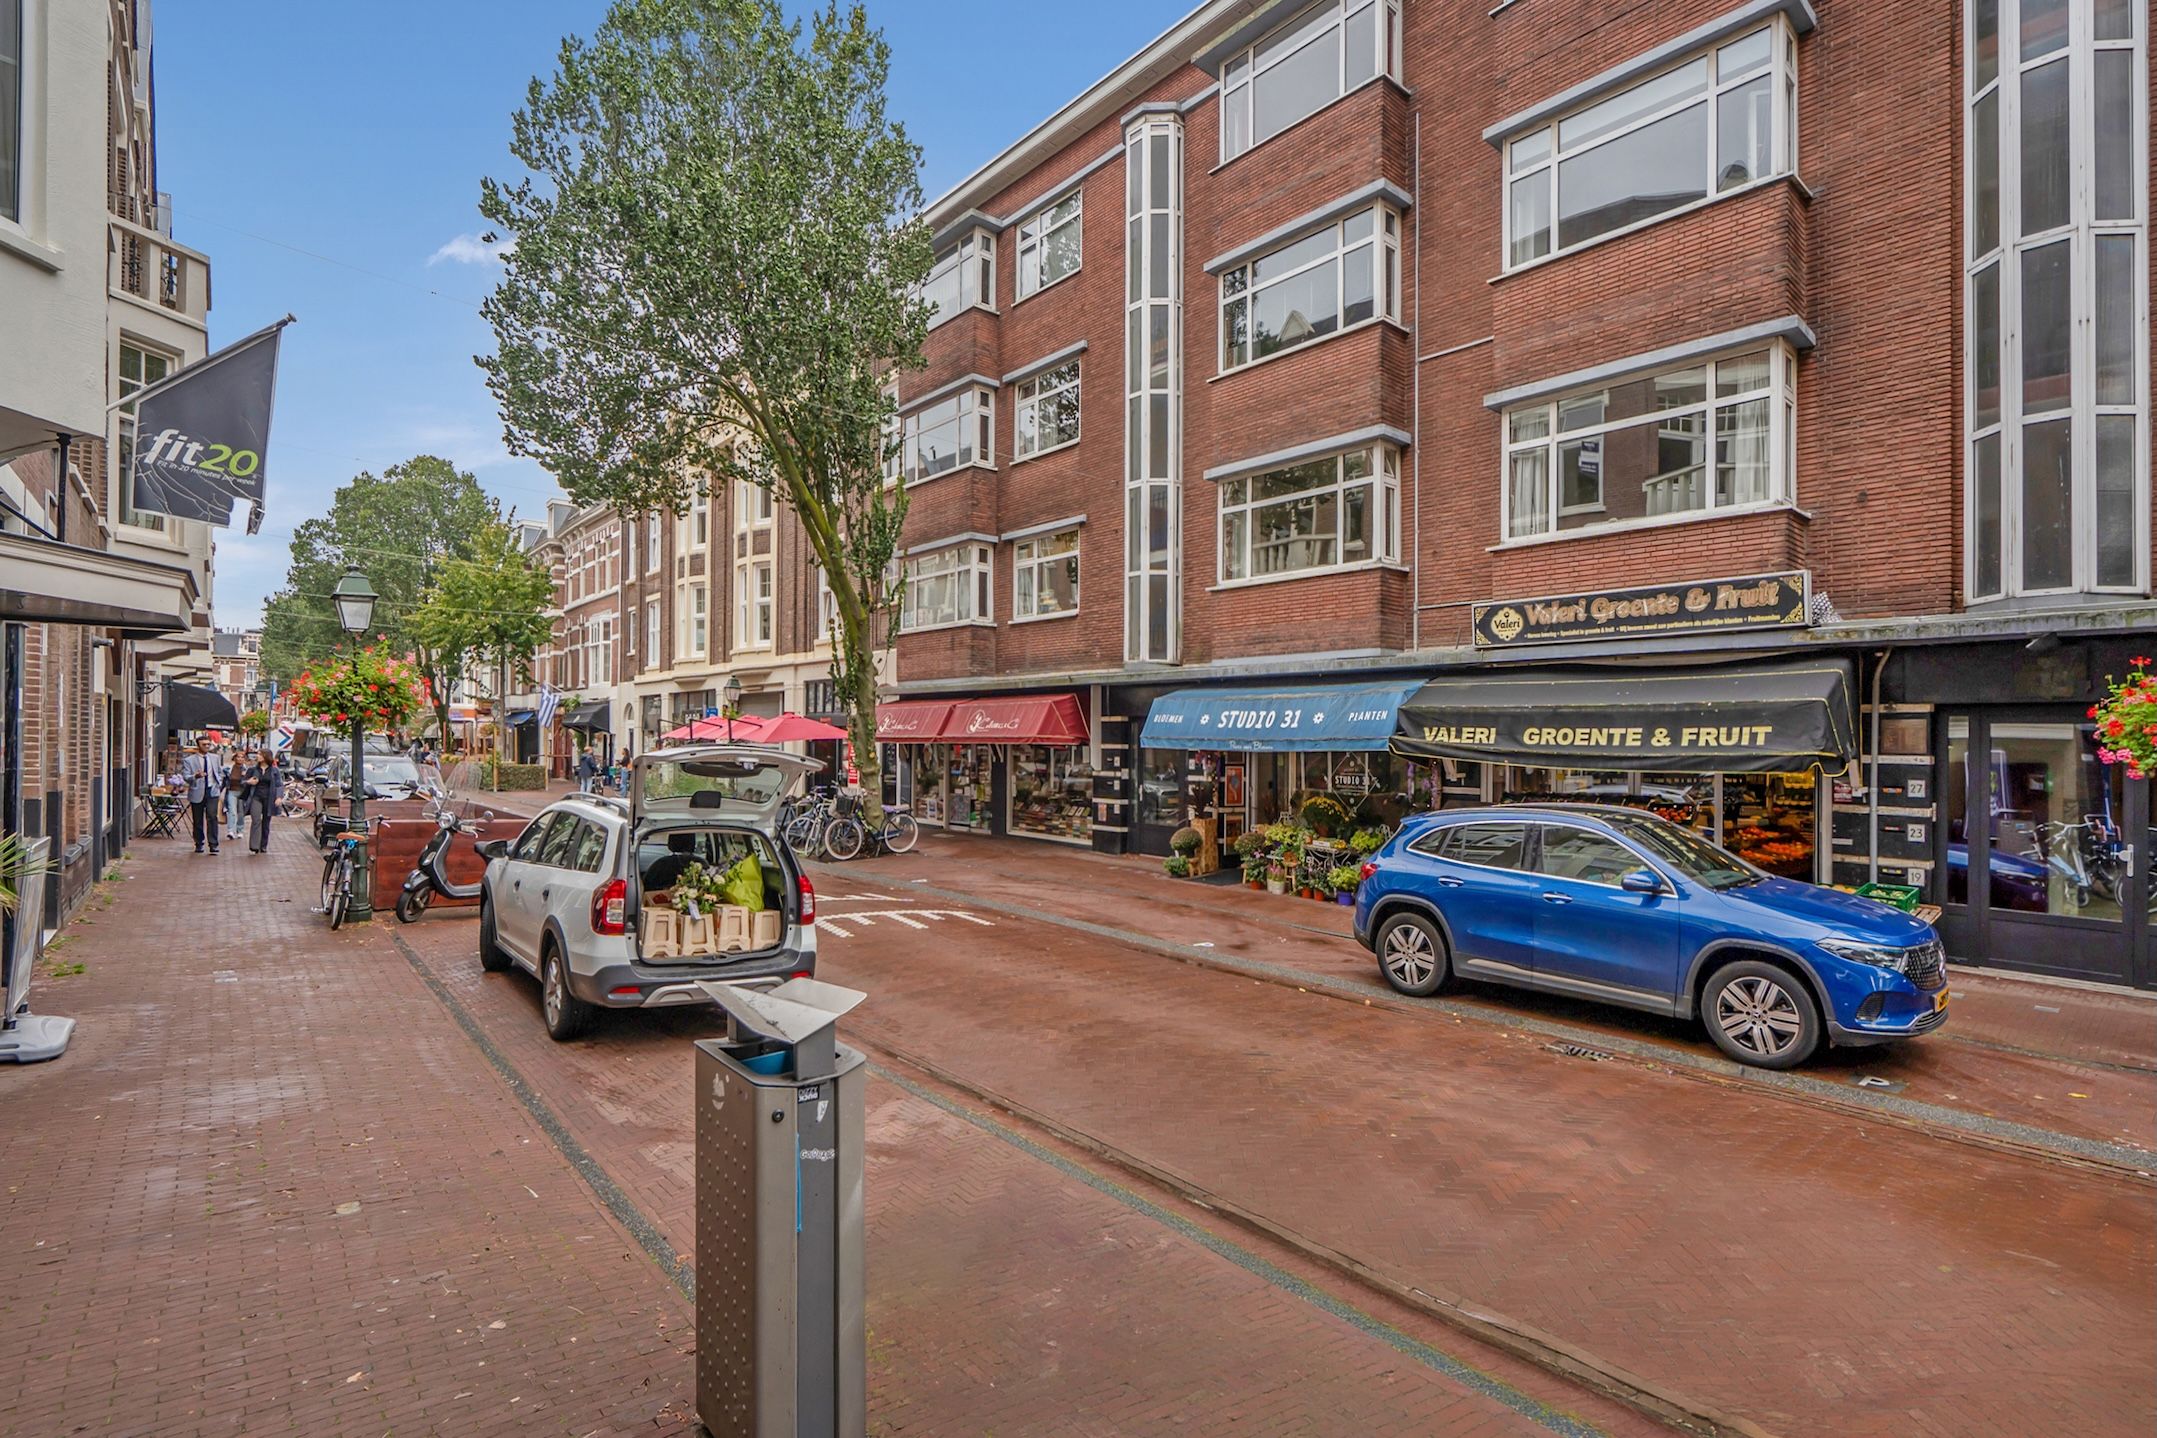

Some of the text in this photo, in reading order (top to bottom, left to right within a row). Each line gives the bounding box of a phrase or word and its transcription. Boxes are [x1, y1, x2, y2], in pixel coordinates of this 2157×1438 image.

[143, 428, 259, 477] fit20
[178, 464, 189, 472] 20
[190, 467, 222, 479] minutes
[1523, 579, 1780, 626] Valeri Groente & Fruit
[1493, 617, 1521, 630] Valeri
[1153, 709, 1388, 729] BLOEMEN STUDIO 31 PLANTEN
[1423, 726, 1773, 747] VALERI GROENTE & FRUIT
[1334, 775, 1360, 785] STUDIO
[1910, 783, 1923, 794] 27
[1909, 828, 1923, 839] 23
[1911, 872, 1922, 882] 19
